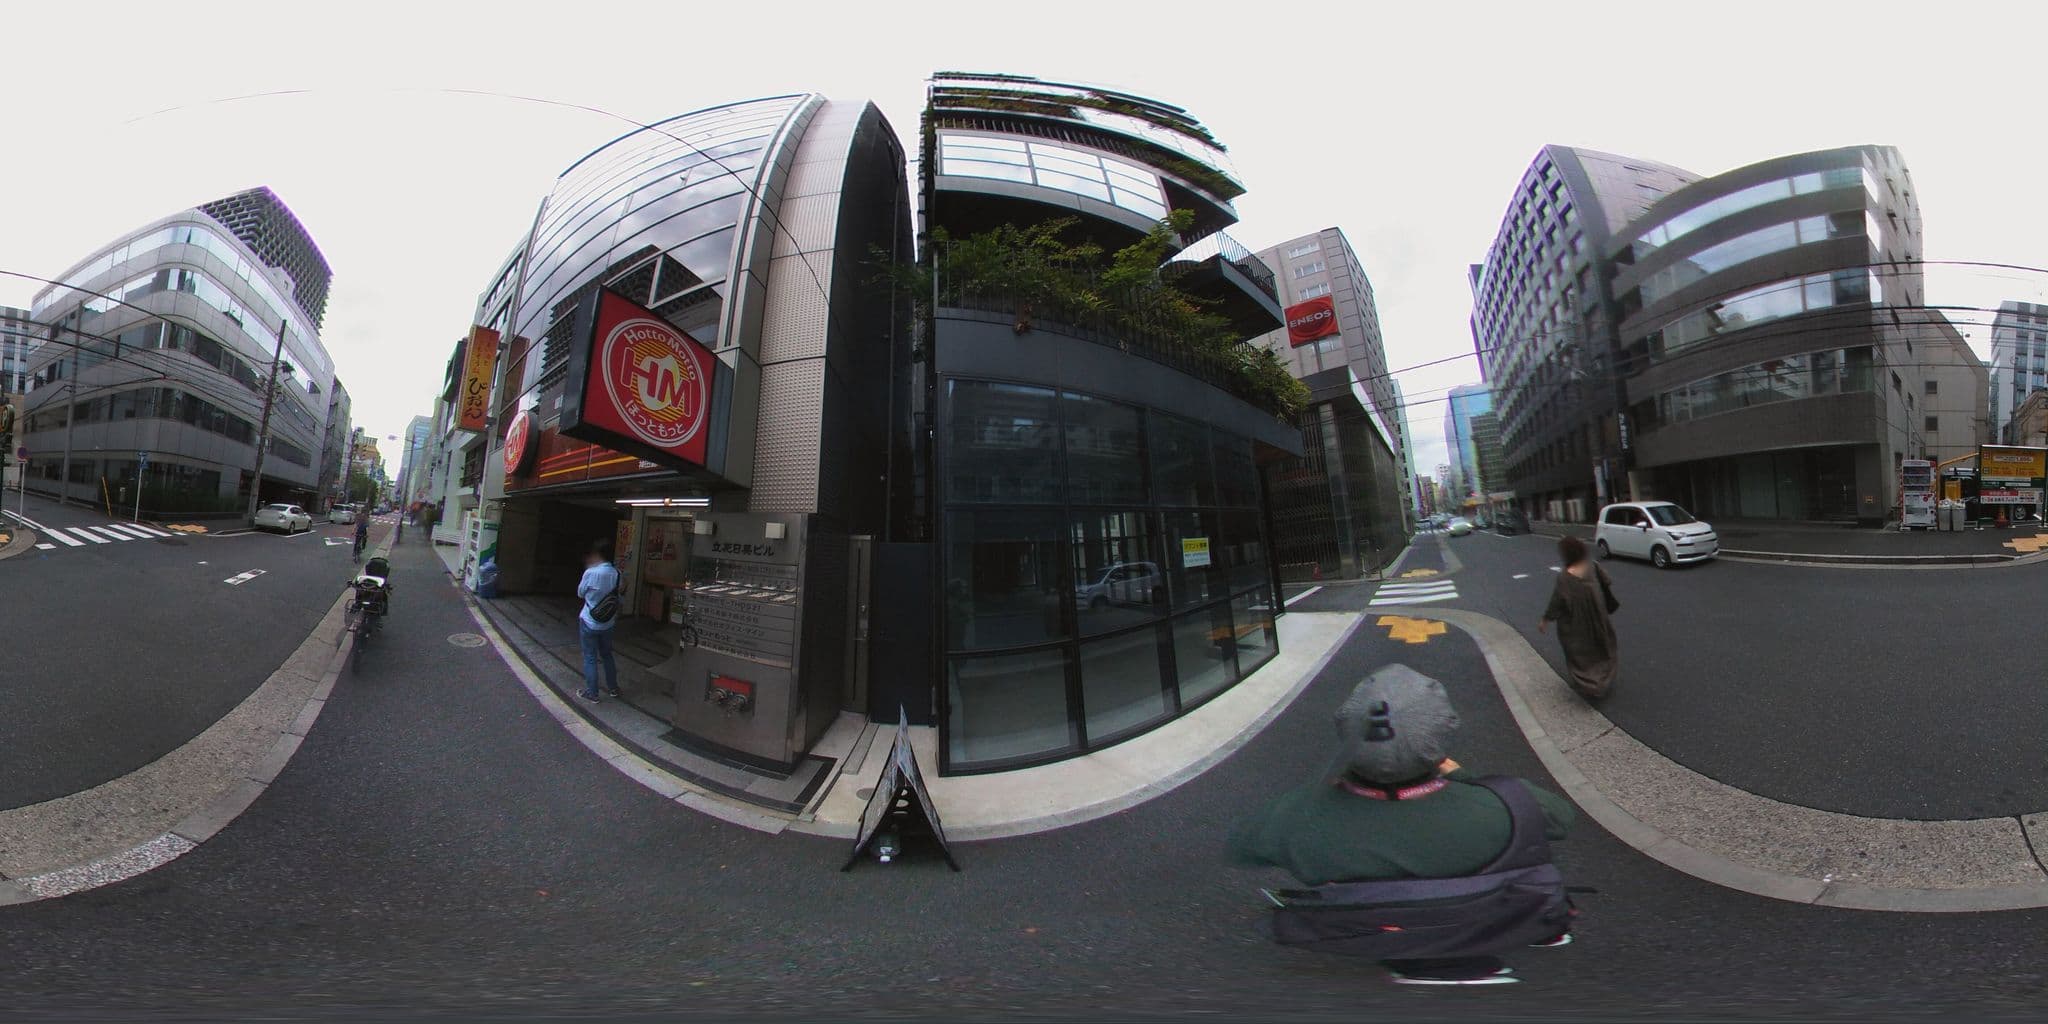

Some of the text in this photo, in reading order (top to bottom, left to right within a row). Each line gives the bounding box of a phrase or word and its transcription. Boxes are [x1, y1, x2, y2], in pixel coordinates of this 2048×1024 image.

[1289, 309, 1332, 328] ENEOS
[622, 329, 696, 380] Hotto Motto
[620, 347, 691, 418] HM
[625, 400, 685, 437] ほっともっと
